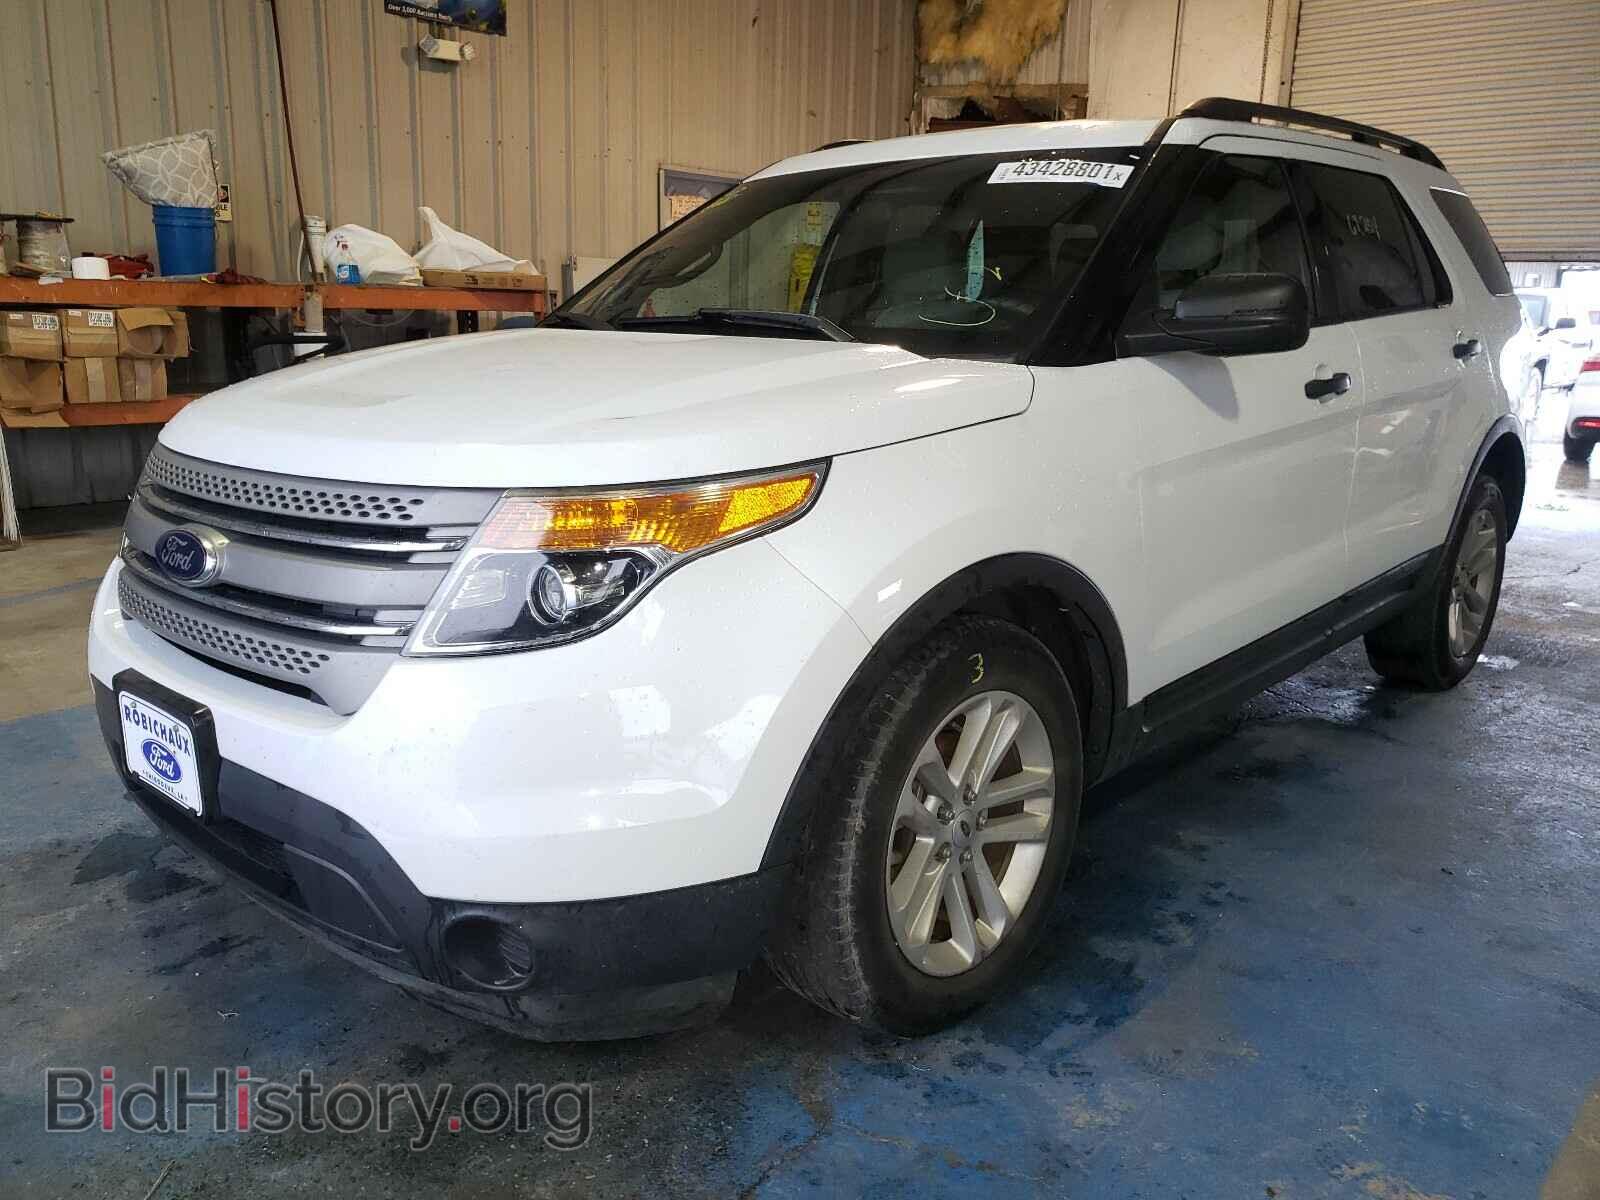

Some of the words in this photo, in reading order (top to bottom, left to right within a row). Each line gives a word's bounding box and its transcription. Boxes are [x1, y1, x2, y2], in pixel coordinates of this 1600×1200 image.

[1013, 161, 1114, 180] 43428801
[160, 534, 199, 573] Ford
[968, 653, 984, 684] 3
[124, 704, 191, 757] ROBICHAUX
[147, 743, 178, 779] Ford
